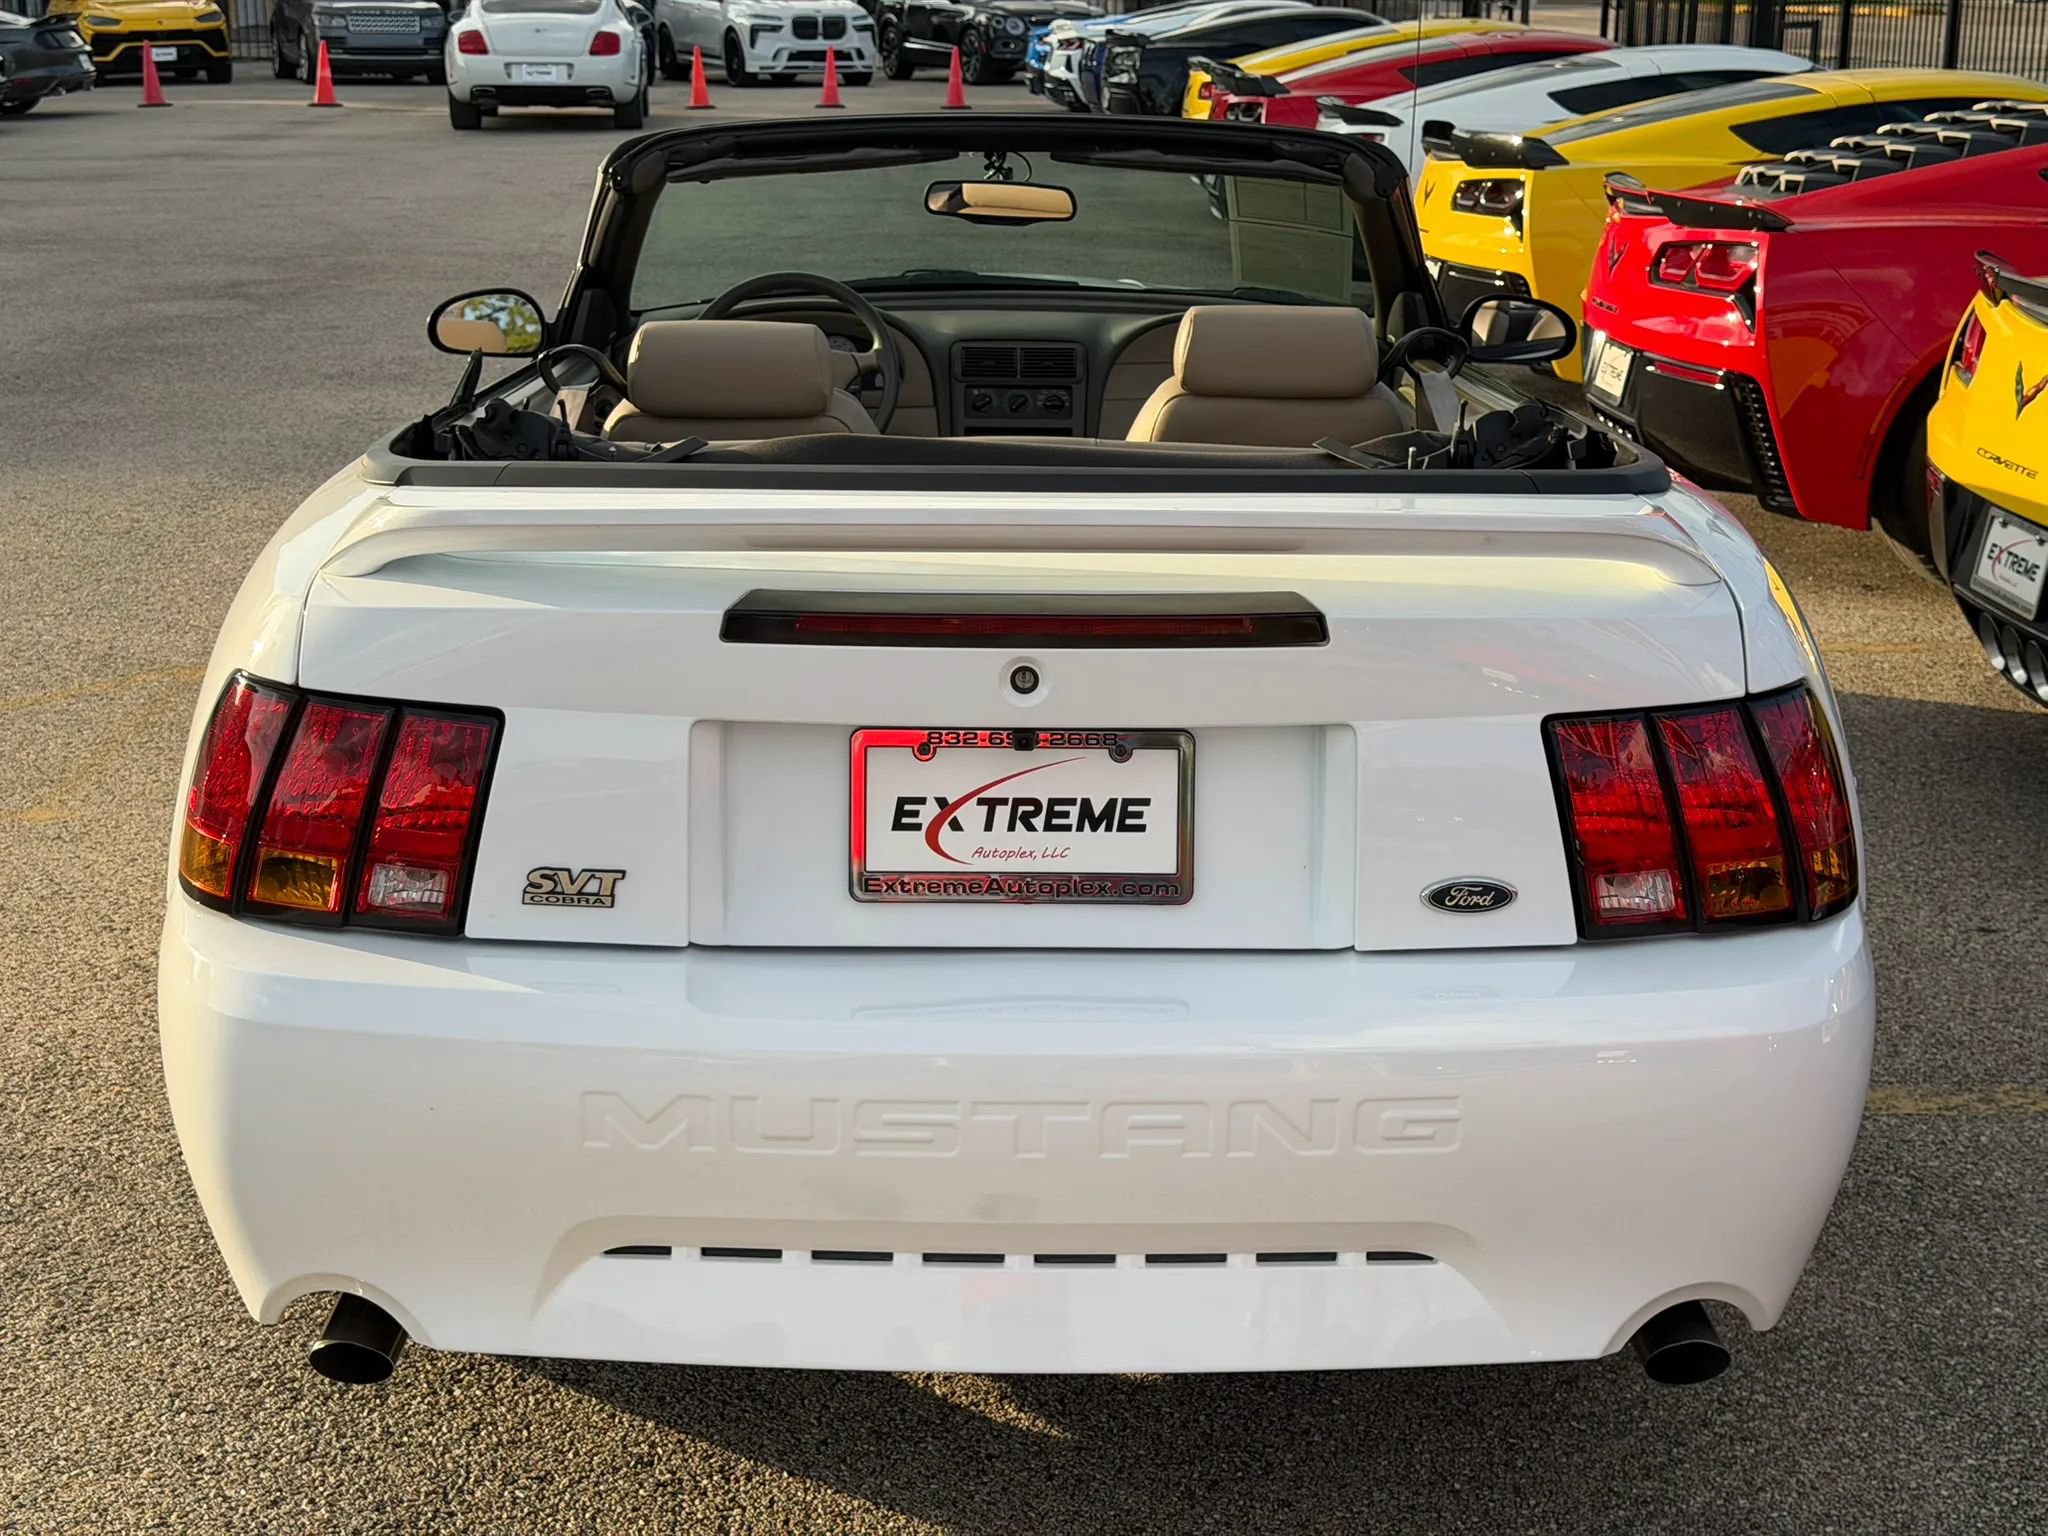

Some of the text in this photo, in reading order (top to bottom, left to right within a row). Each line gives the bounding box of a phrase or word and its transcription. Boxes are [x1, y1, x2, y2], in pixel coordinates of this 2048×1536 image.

[1987, 542, 2041, 582] EXTREME
[927, 731, 1118, 746] 832-6-2668
[891, 796, 1152, 833] EXTREME
[971, 846, 1071, 861] Autoplex, LLC
[522, 865, 627, 896] SVT
[862, 876, 1180, 899] ExtremeAutoplex.com
[528, 894, 607, 906] COBRA
[1445, 886, 1496, 906] Ford
[580, 1090, 1463, 1159] MUSTANG
